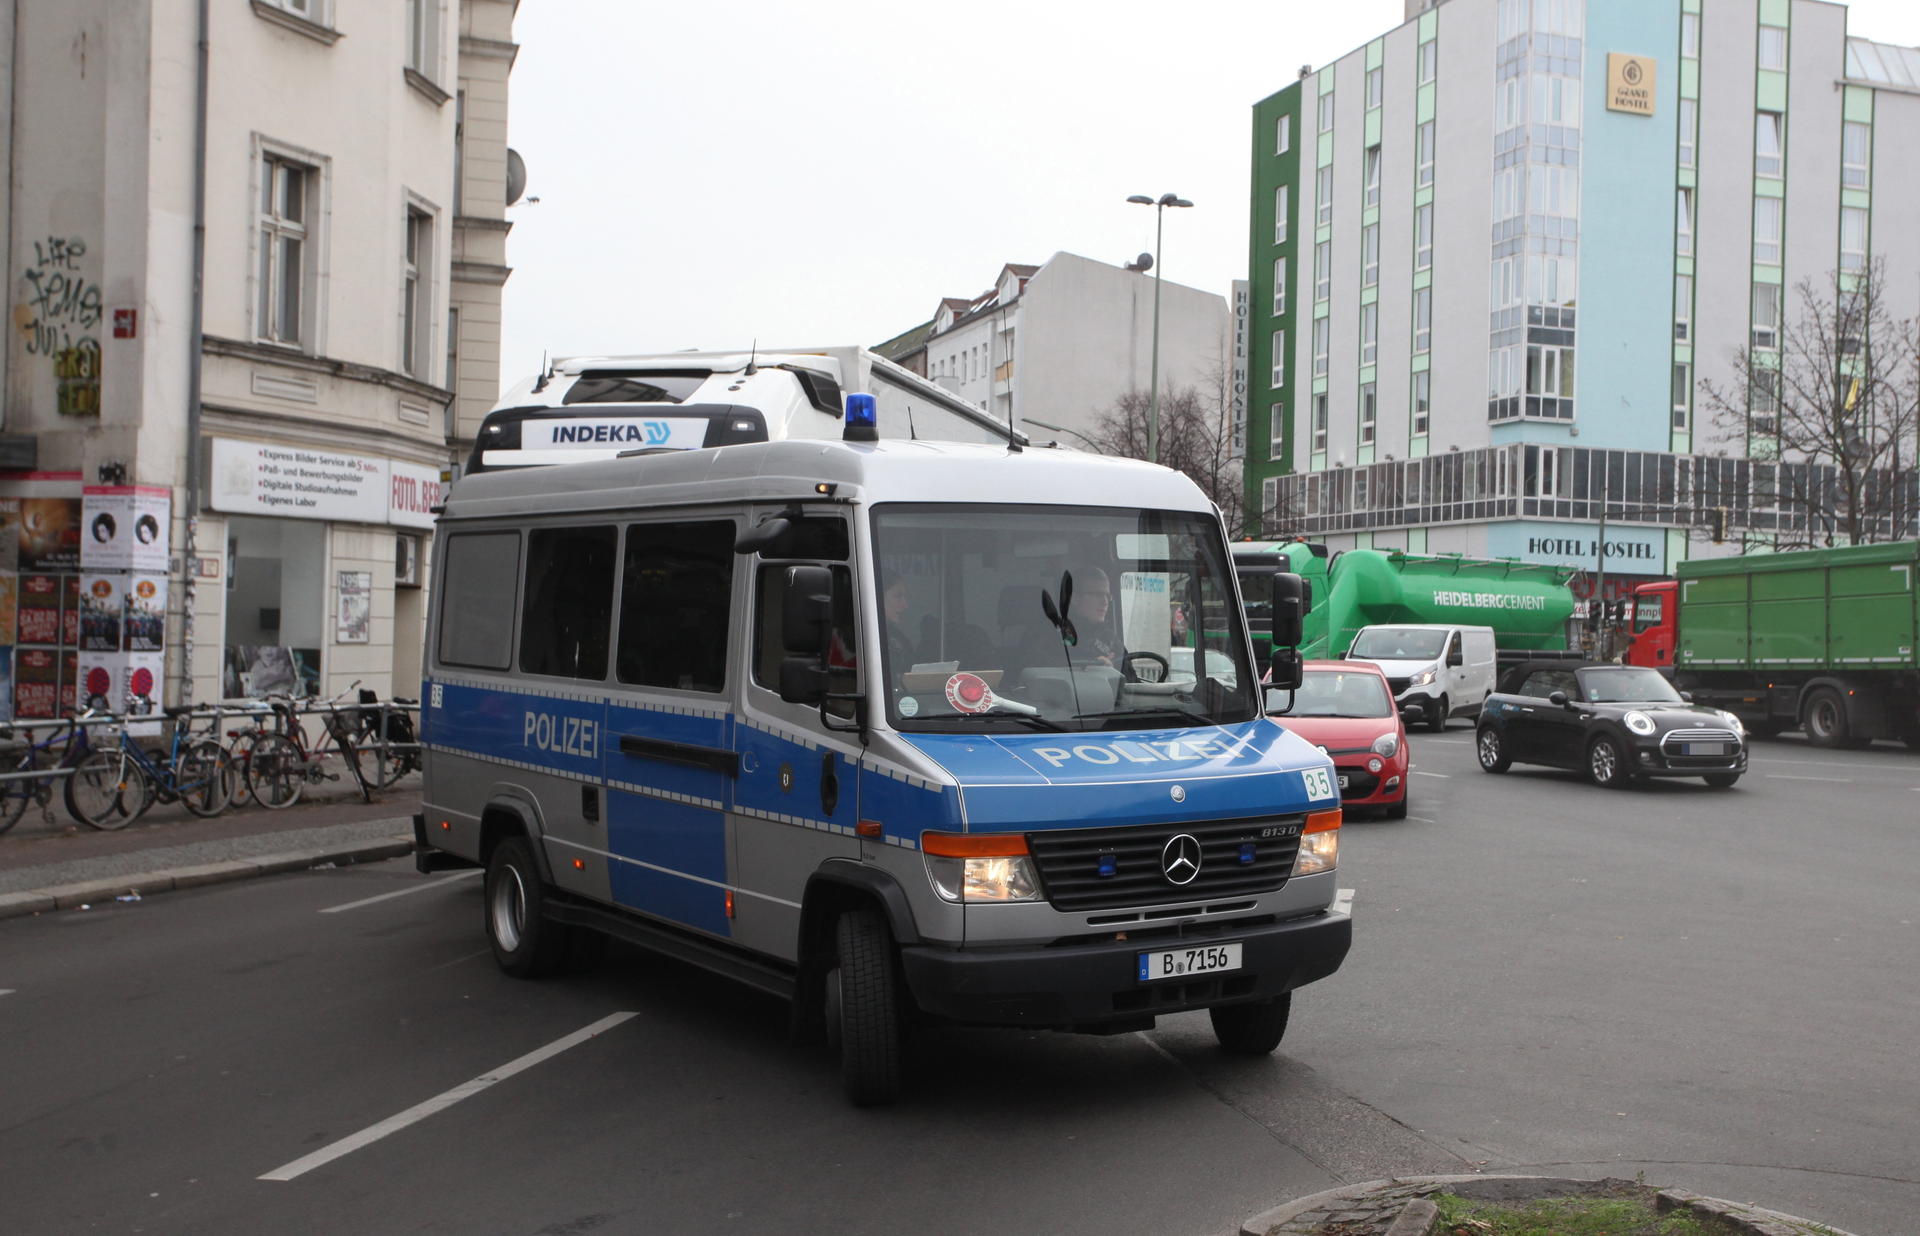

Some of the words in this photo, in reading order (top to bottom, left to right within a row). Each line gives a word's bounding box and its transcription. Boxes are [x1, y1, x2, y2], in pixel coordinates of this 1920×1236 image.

[1615, 96, 1649, 109] HOSTEL
[1236, 291, 1247, 358] HOTEL
[1234, 369, 1245, 448] HOSTEL
[552, 425, 643, 443] INDEKA
[263, 449, 293, 462] Express
[295, 452, 317, 464] Bilder
[319, 456, 345, 467] Service
[347, 458, 356, 468] ab
[356, 460, 362, 471] 5
[283, 468, 298, 477] und
[299, 469, 364, 483] Bewerbungsbilder
[263, 479, 292, 491] Digitale
[294, 482, 358, 496] Studioaufnahmen
[392, 474, 416, 512] FOTO
[263, 494, 293, 507] Eigenes
[295, 497, 317, 508] Labor
[1529, 537, 1585, 556] HOTEL
[1591, 541, 1655, 559] HOSTEL
[1433, 590, 1545, 610] HEIDELBERGCEMENT
[432, 684, 442, 706] 35
[524, 711, 598, 759] POLIZEI
[1032, 739, 1245, 767] POLIZEI
[1305, 771, 1329, 797] 35
[1262, 827, 1286, 838] 813
[1163, 953, 1174, 975] B
[1186, 947, 1228, 972] 7156
